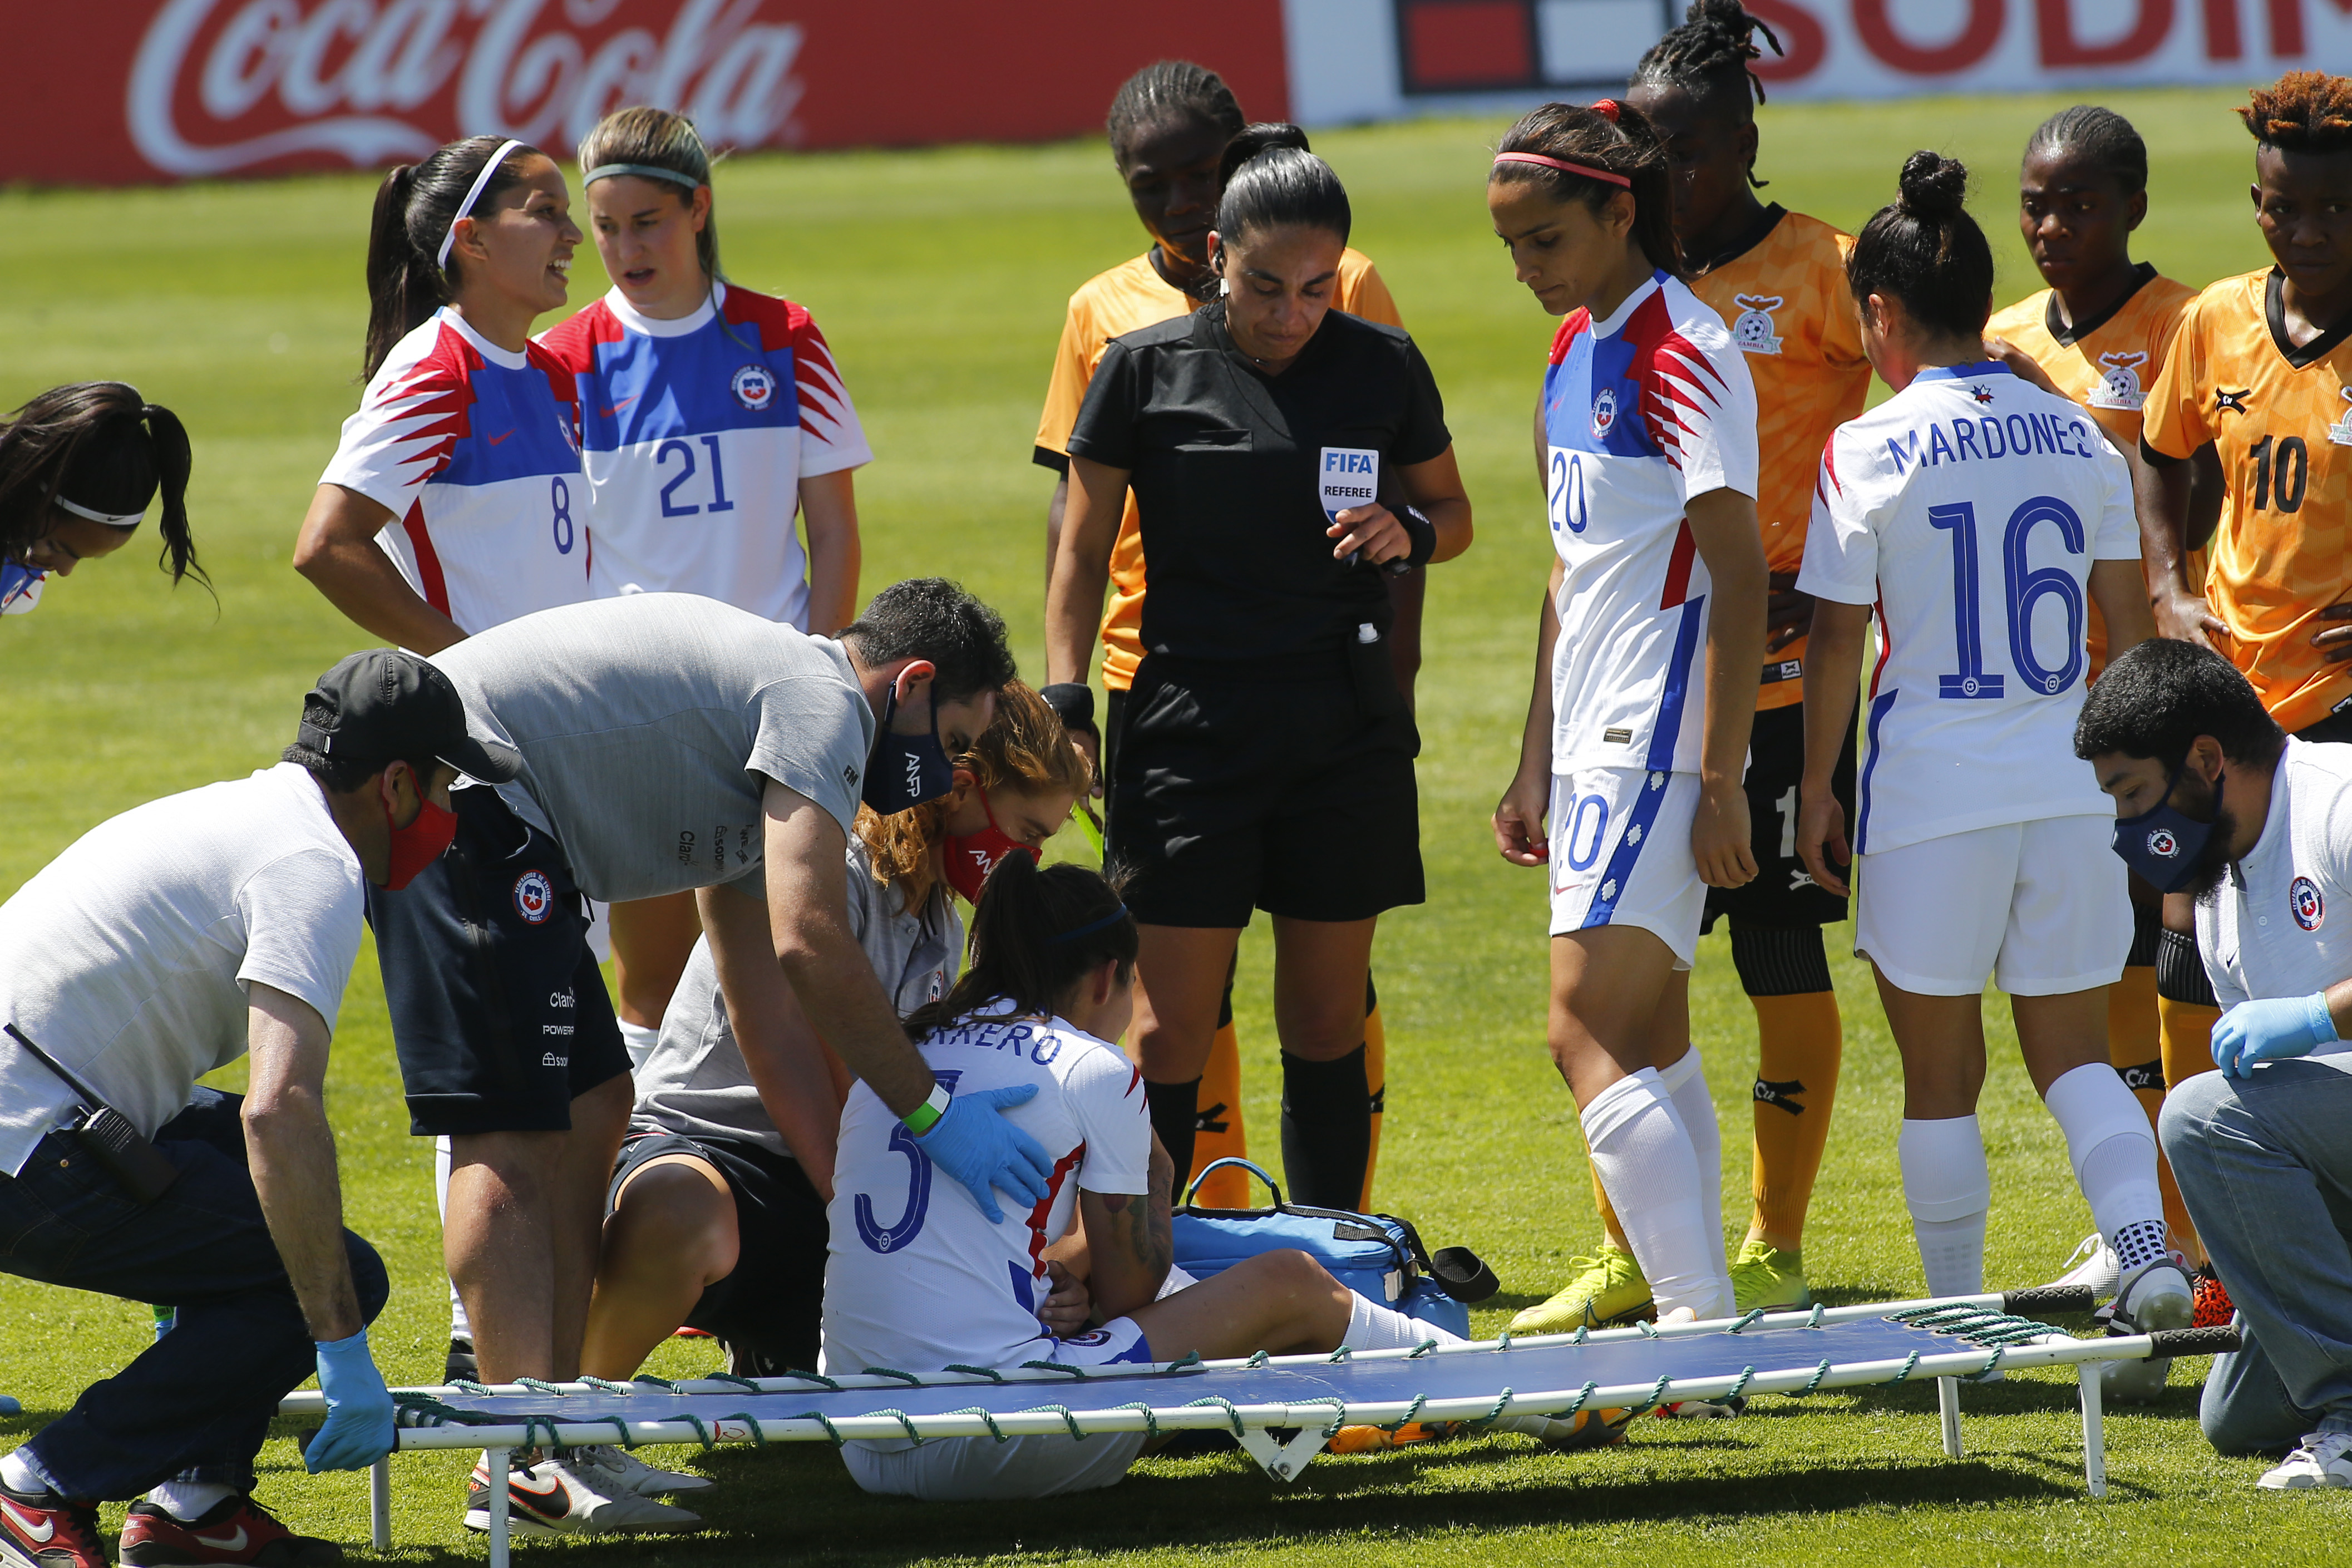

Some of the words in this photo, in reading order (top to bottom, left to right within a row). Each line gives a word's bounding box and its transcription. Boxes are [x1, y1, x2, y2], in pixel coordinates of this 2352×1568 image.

[1325, 452, 1373, 474] FIFA
[1887, 413, 2093, 476] MARDONES
[657, 435, 734, 518] 21
[1324, 485, 1372, 498] REFEREE
[1551, 451, 1587, 533] 20
[2250, 435, 2307, 514] 10
[551, 476, 574, 554] 8
[1928, 495, 2085, 699] 16
[843, 765, 859, 788] FM
[905, 752, 920, 797] ANFP
[678, 830, 695, 862] Claro
[1776, 785, 1796, 857] 1
[550, 992, 575, 1008] Claro
[2125, 1068, 2149, 1087] Cu
